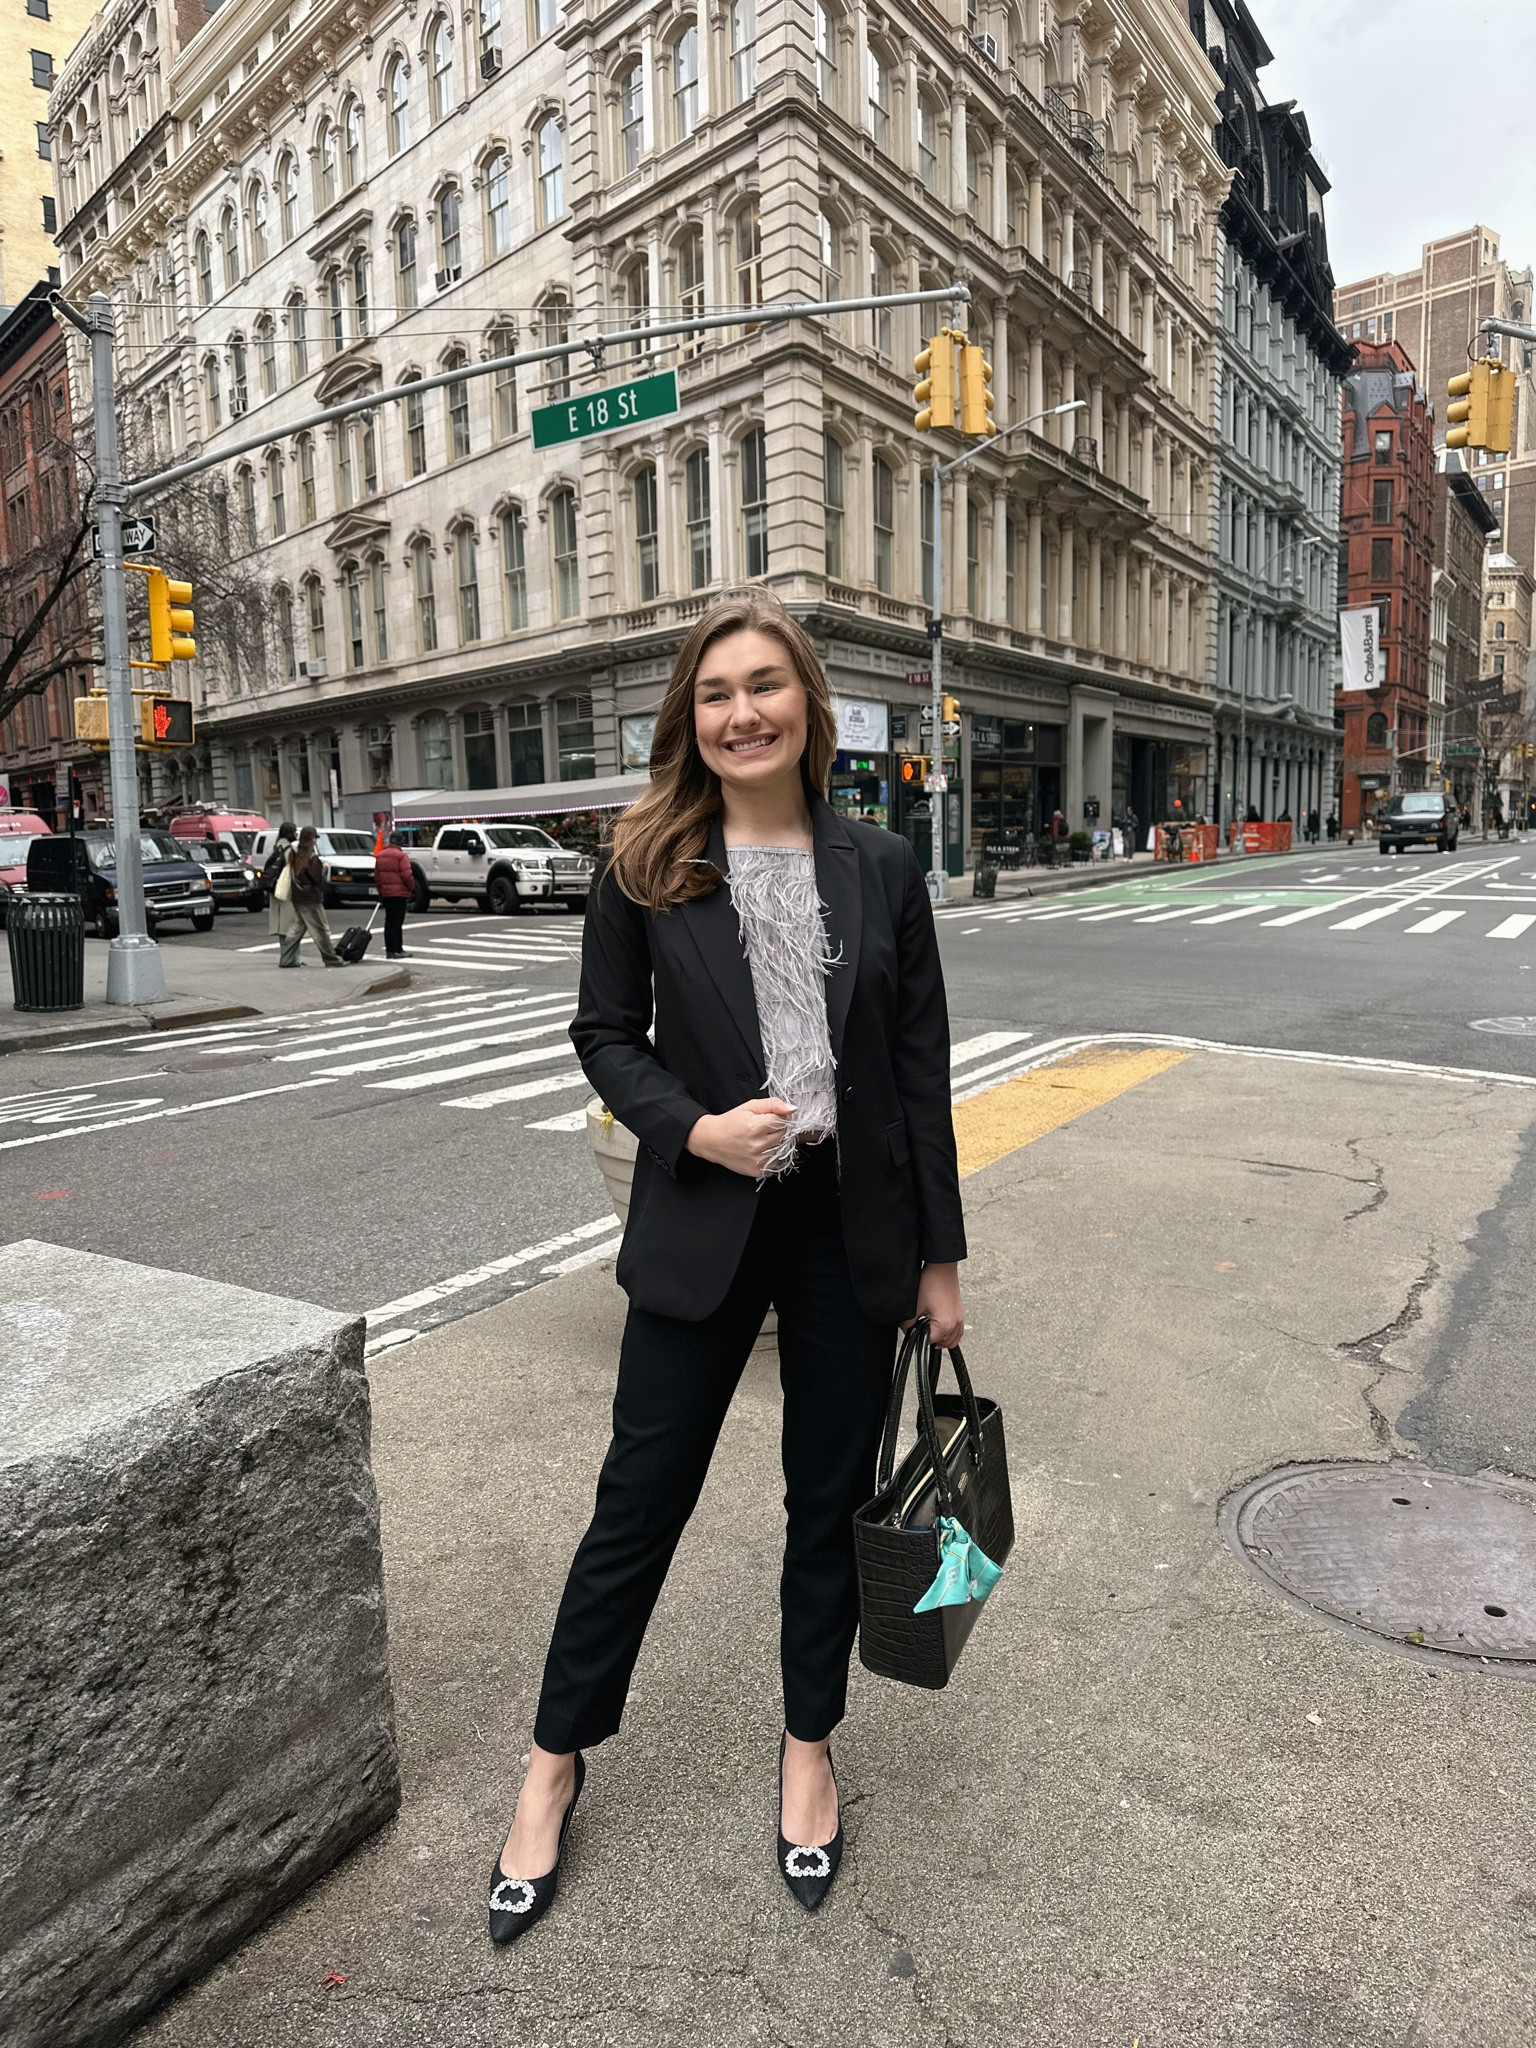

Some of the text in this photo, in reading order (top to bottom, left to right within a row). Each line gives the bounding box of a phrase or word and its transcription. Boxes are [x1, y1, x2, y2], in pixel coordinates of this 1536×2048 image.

[568, 389, 638, 432] E 18 St
[125, 528, 146, 544] WAY
